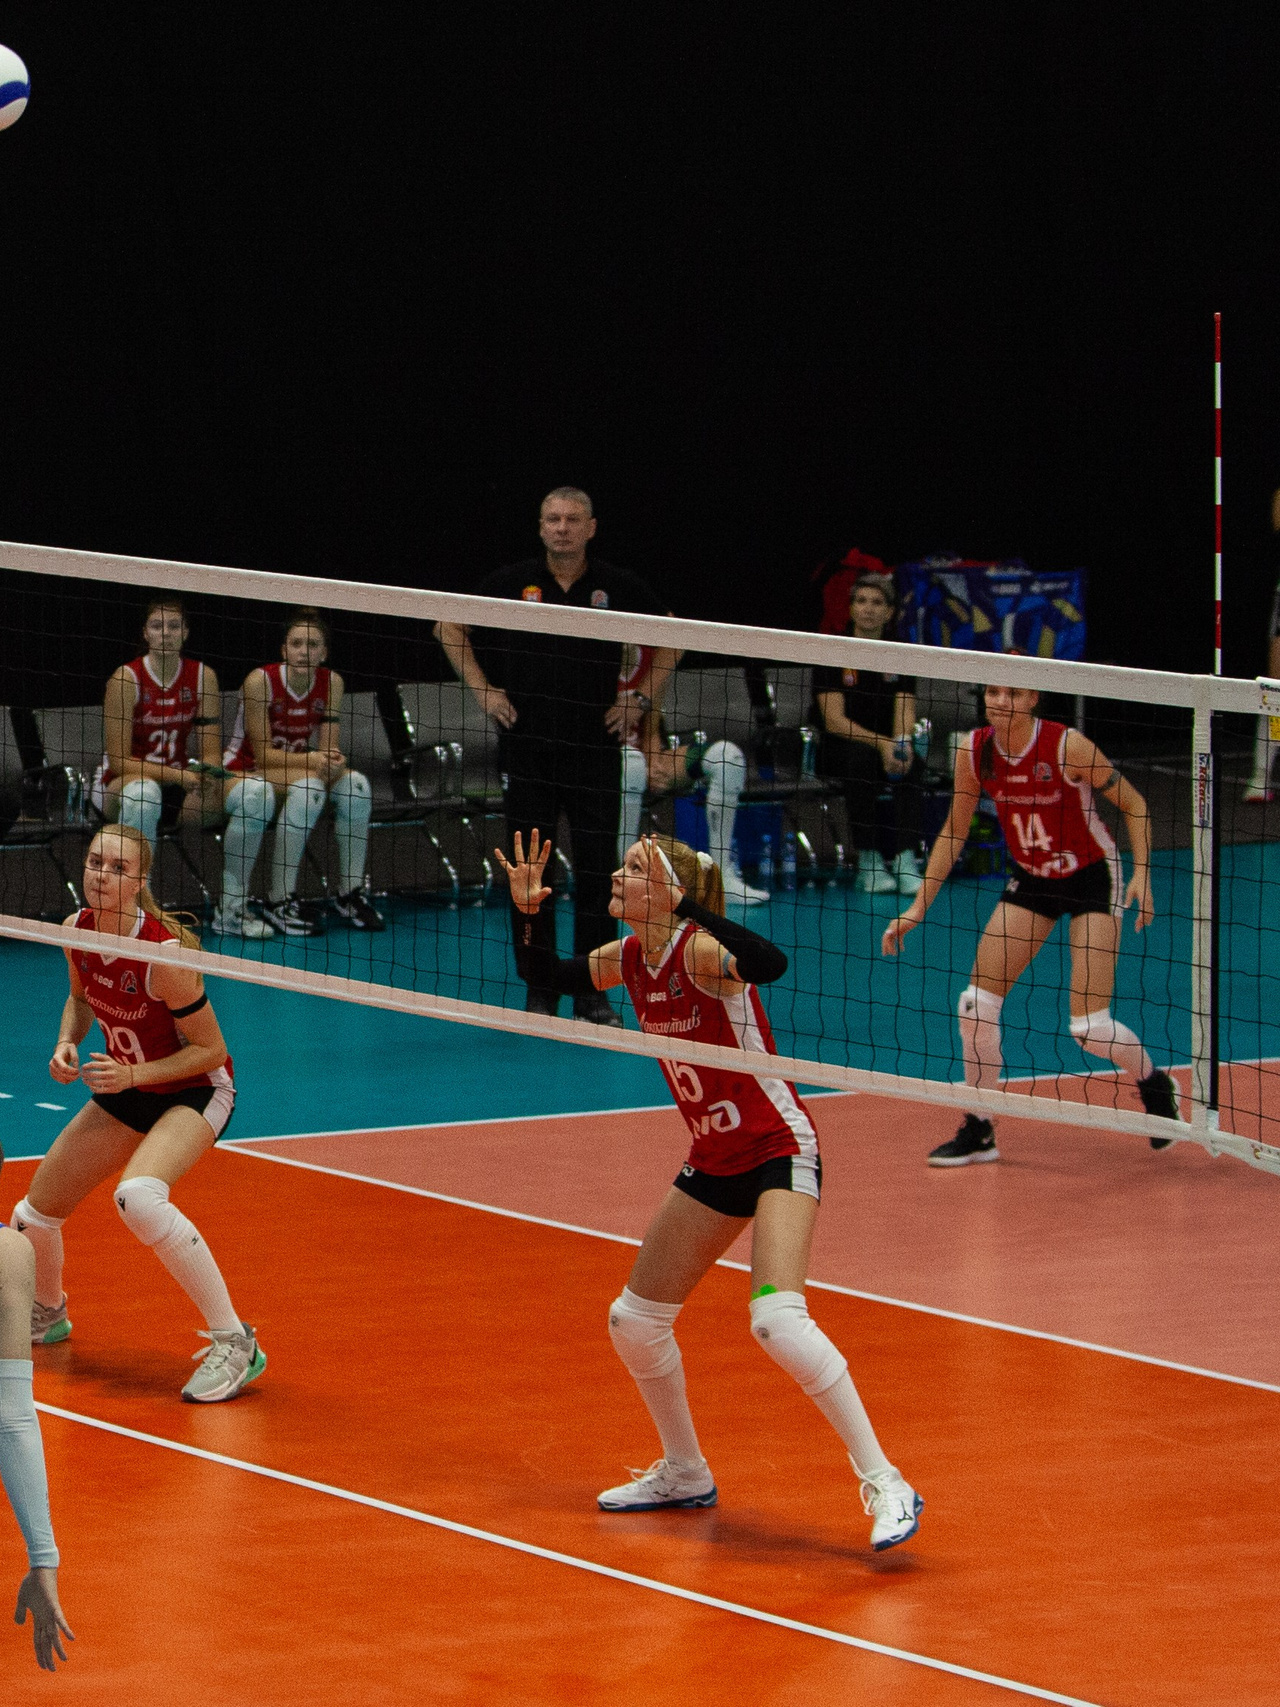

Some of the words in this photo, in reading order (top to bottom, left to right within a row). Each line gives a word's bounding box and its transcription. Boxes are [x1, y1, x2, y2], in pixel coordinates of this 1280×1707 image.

[145, 729, 180, 764] 21
[1011, 812, 1054, 856] 14
[662, 1058, 704, 1103] 15
